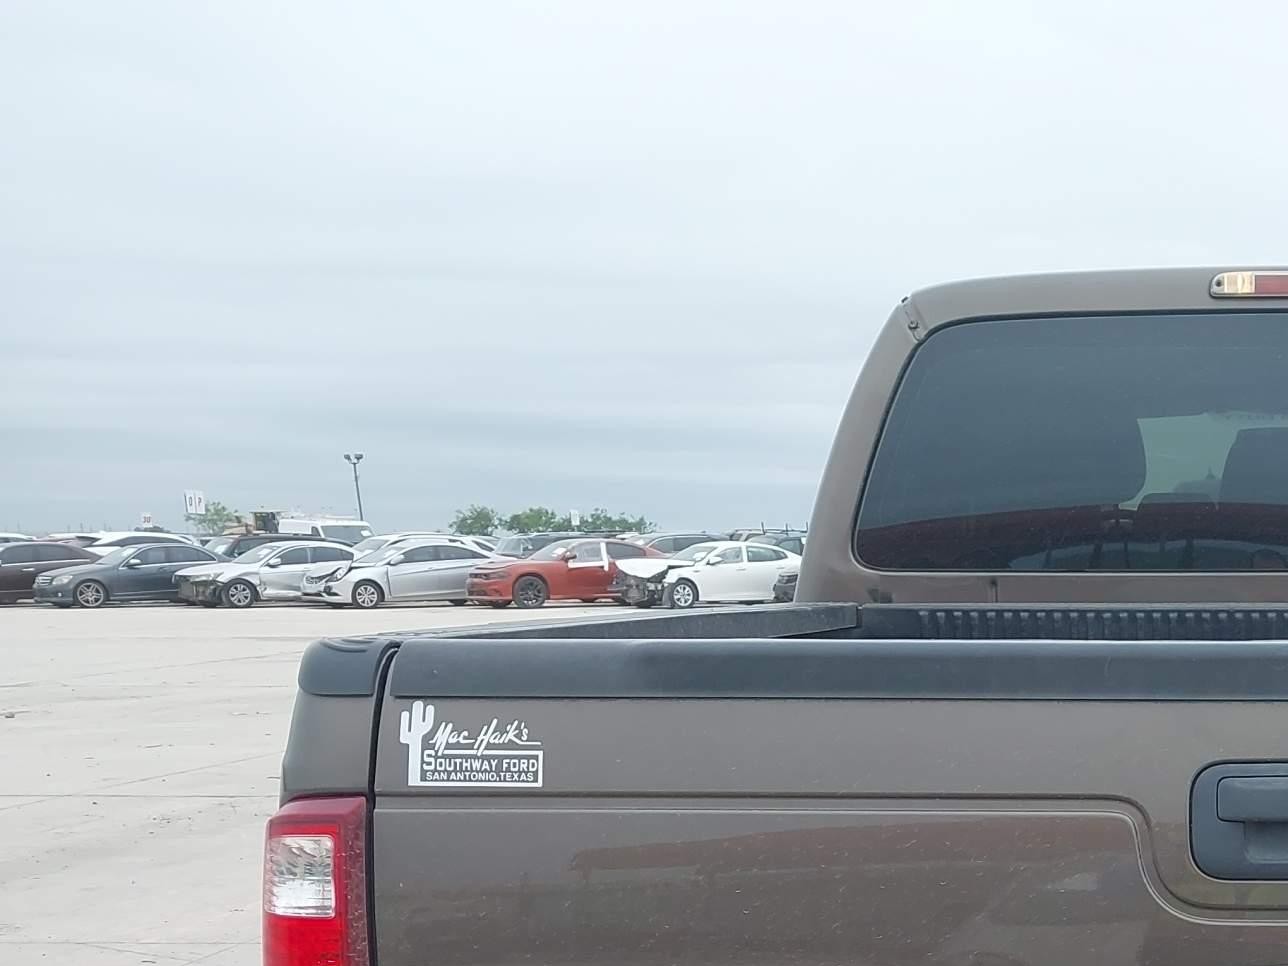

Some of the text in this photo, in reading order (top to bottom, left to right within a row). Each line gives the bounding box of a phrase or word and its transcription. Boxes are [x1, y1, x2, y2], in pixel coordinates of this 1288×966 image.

[429, 718, 541, 756] Mac Haik's
[423, 750, 537, 772] SOUTHWAY FORD
[426, 771, 447, 781] SAN
